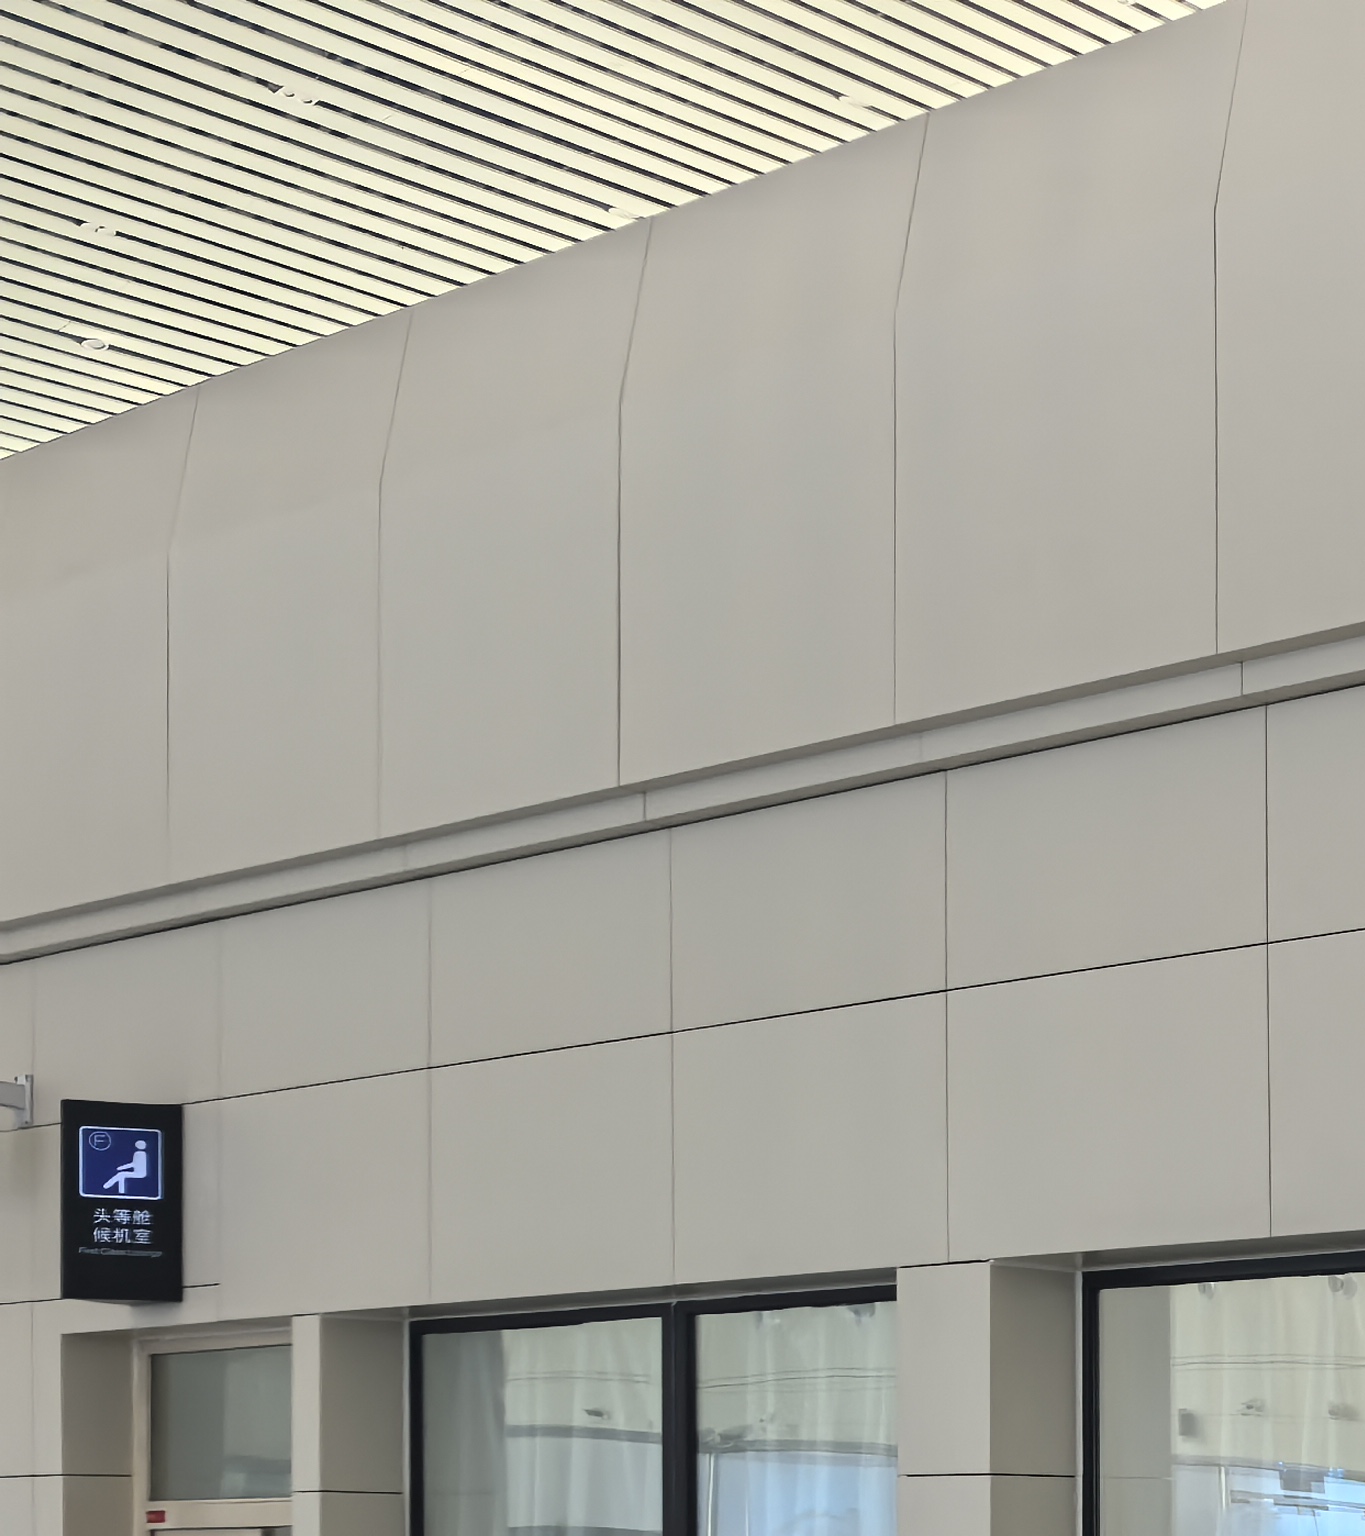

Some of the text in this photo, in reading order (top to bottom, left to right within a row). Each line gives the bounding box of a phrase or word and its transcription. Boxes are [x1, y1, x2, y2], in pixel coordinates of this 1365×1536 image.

[93, 1208, 153, 1225] 头等舱
[93, 1227, 153, 1244] 候机室
